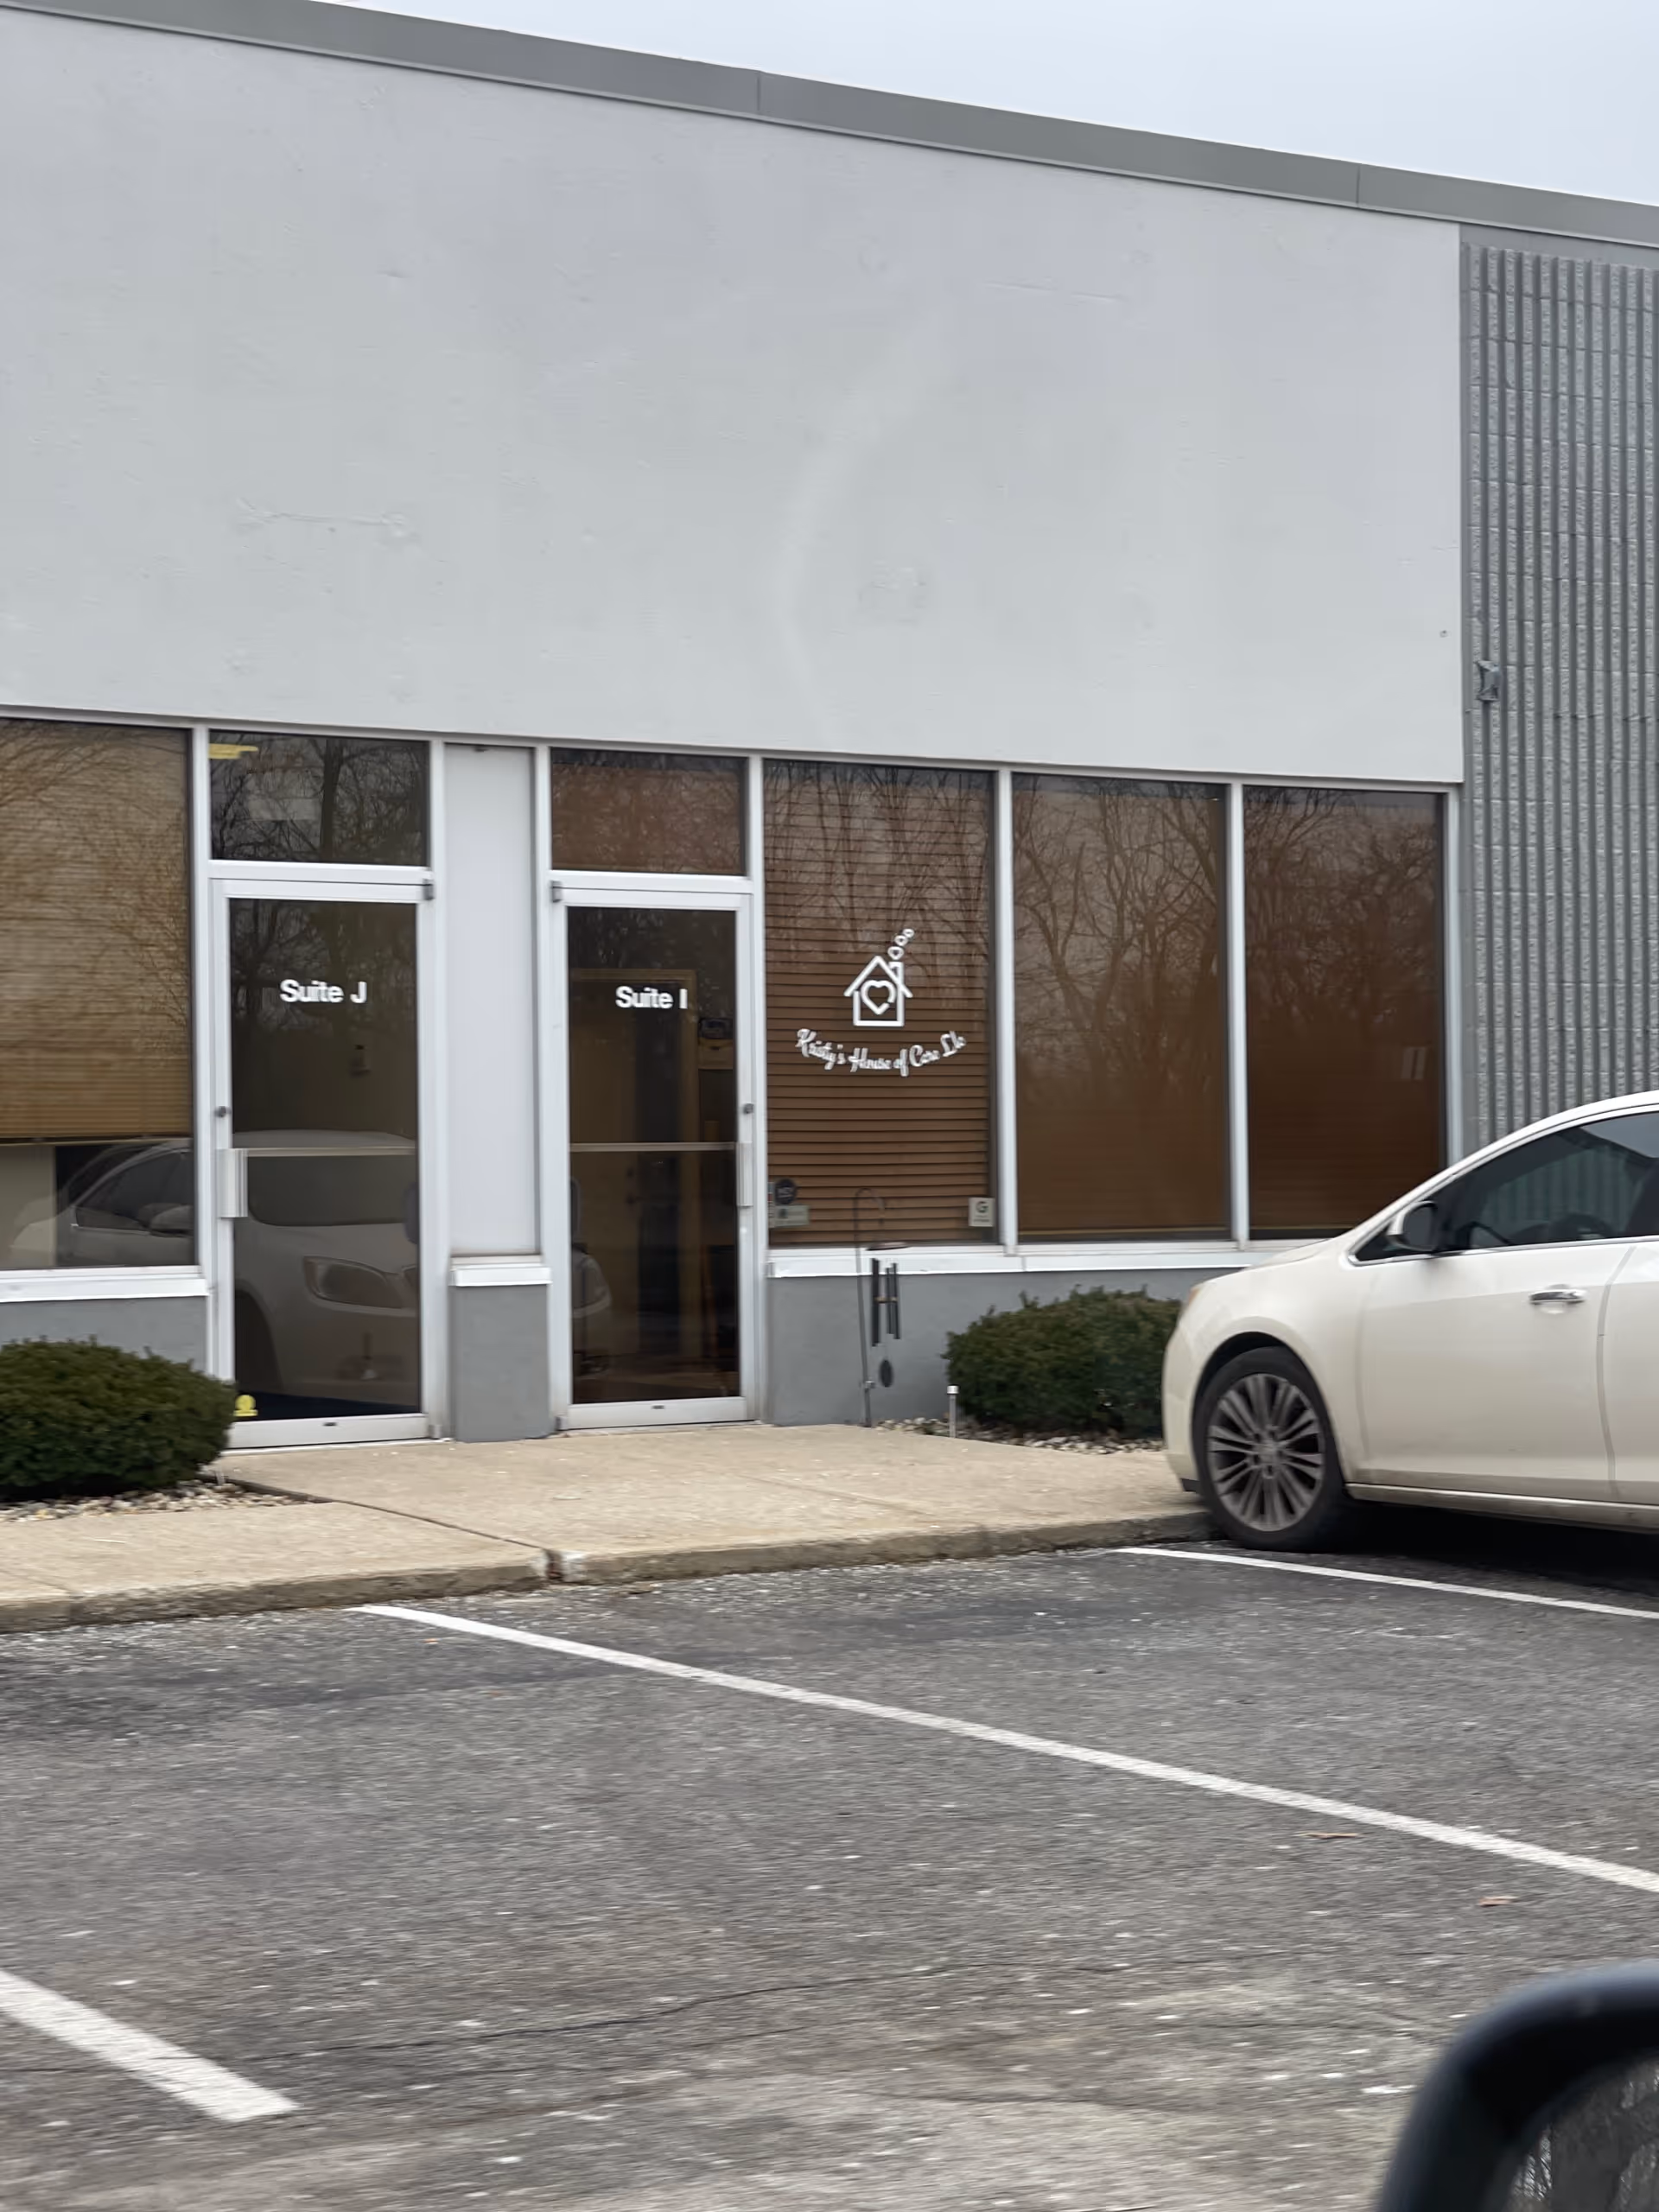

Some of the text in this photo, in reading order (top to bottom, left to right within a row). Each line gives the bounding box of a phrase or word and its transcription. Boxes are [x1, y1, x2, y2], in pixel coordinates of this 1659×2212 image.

[280, 979, 367, 1003] Suite J
[615, 985, 688, 1009] Suite I
[849, 1047, 891, 1072] House
[893, 1048, 909, 1077] of
